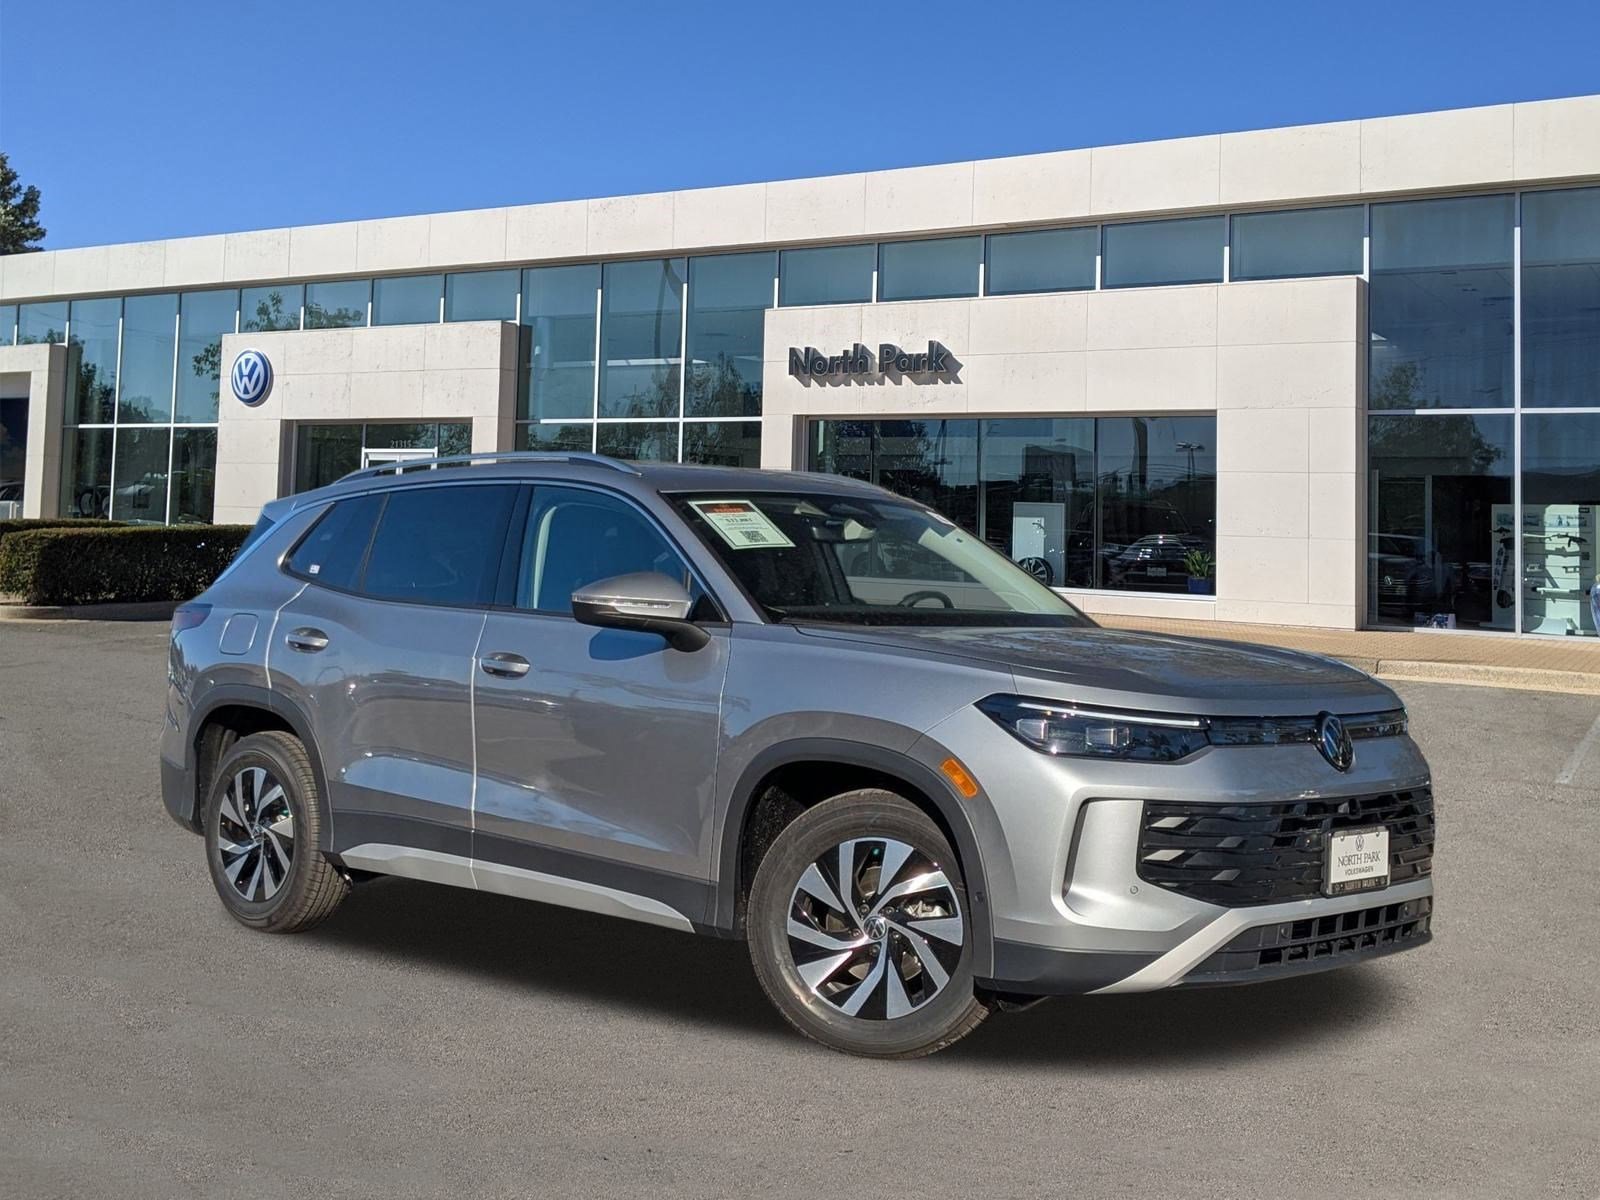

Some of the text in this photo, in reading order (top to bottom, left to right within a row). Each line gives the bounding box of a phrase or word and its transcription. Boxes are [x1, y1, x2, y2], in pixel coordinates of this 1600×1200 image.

[788, 340, 947, 375] North Park
[1337, 850, 1381, 867] NORTH PARK
